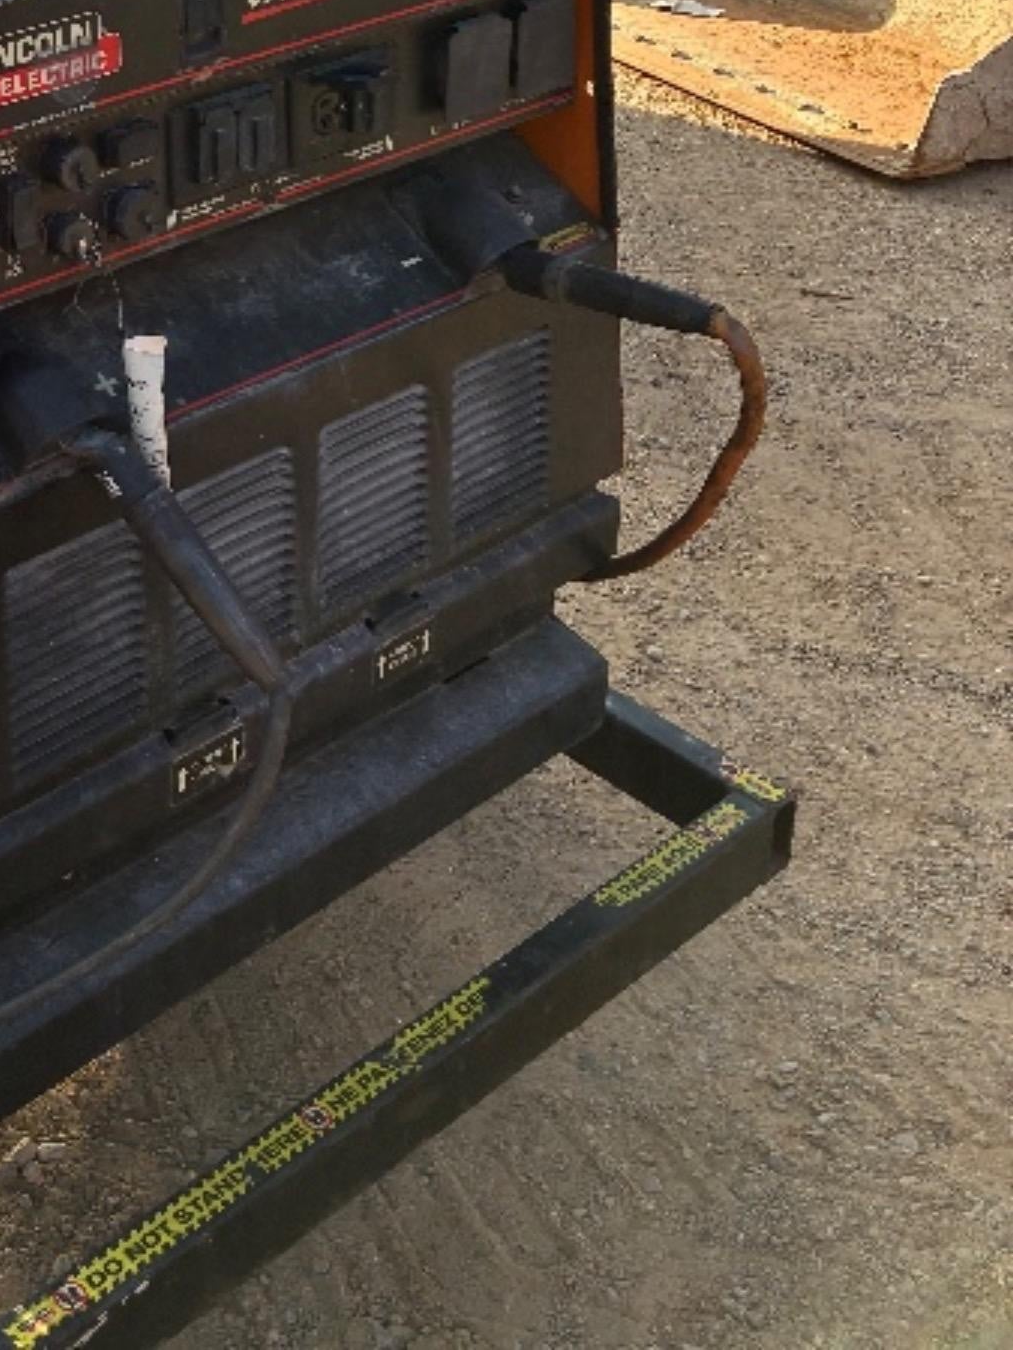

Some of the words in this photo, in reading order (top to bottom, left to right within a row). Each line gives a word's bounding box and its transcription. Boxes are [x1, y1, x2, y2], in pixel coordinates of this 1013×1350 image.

[86, 1258, 124, 1289] DO
[124, 1219, 173, 1263] NOT
[172, 1167, 246, 1224] STAND
